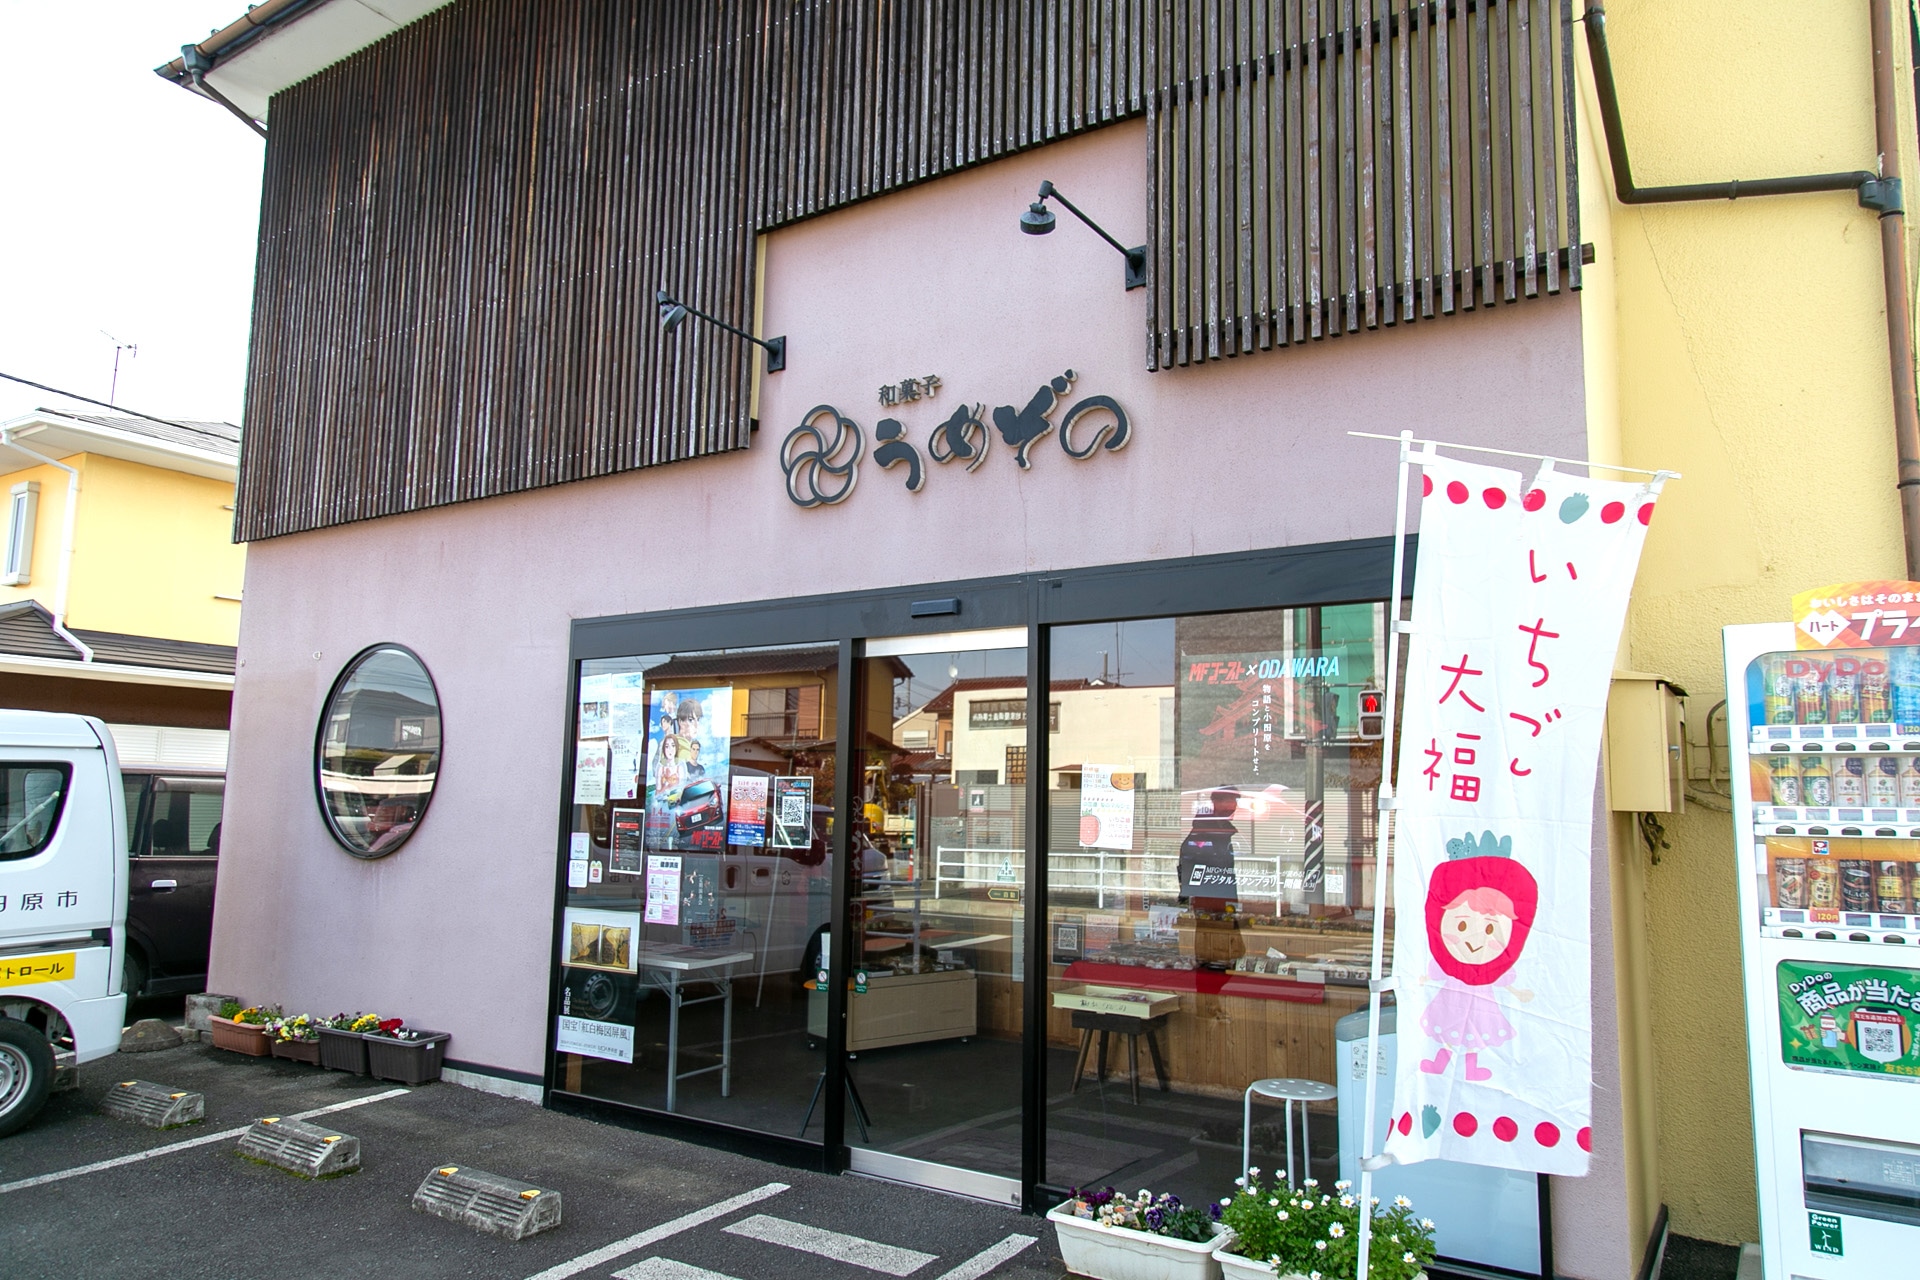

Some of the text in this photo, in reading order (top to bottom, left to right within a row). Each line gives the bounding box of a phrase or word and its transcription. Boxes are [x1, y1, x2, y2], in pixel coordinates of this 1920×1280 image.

[878, 374, 942, 407] 和菓子
[1810, 620, 1839, 632] ハート
[1510, 549, 1578, 776] いちご
[1785, 658, 1886, 682] DyDo
[1423, 654, 1485, 802] 大福
[0, 962, 65, 980] トロール
[562, 1019, 631, 1041] 国宝「紅白梅図屏風」
[1811, 1213, 1838, 1223] Green
[1811, 1219, 1839, 1229] Power
